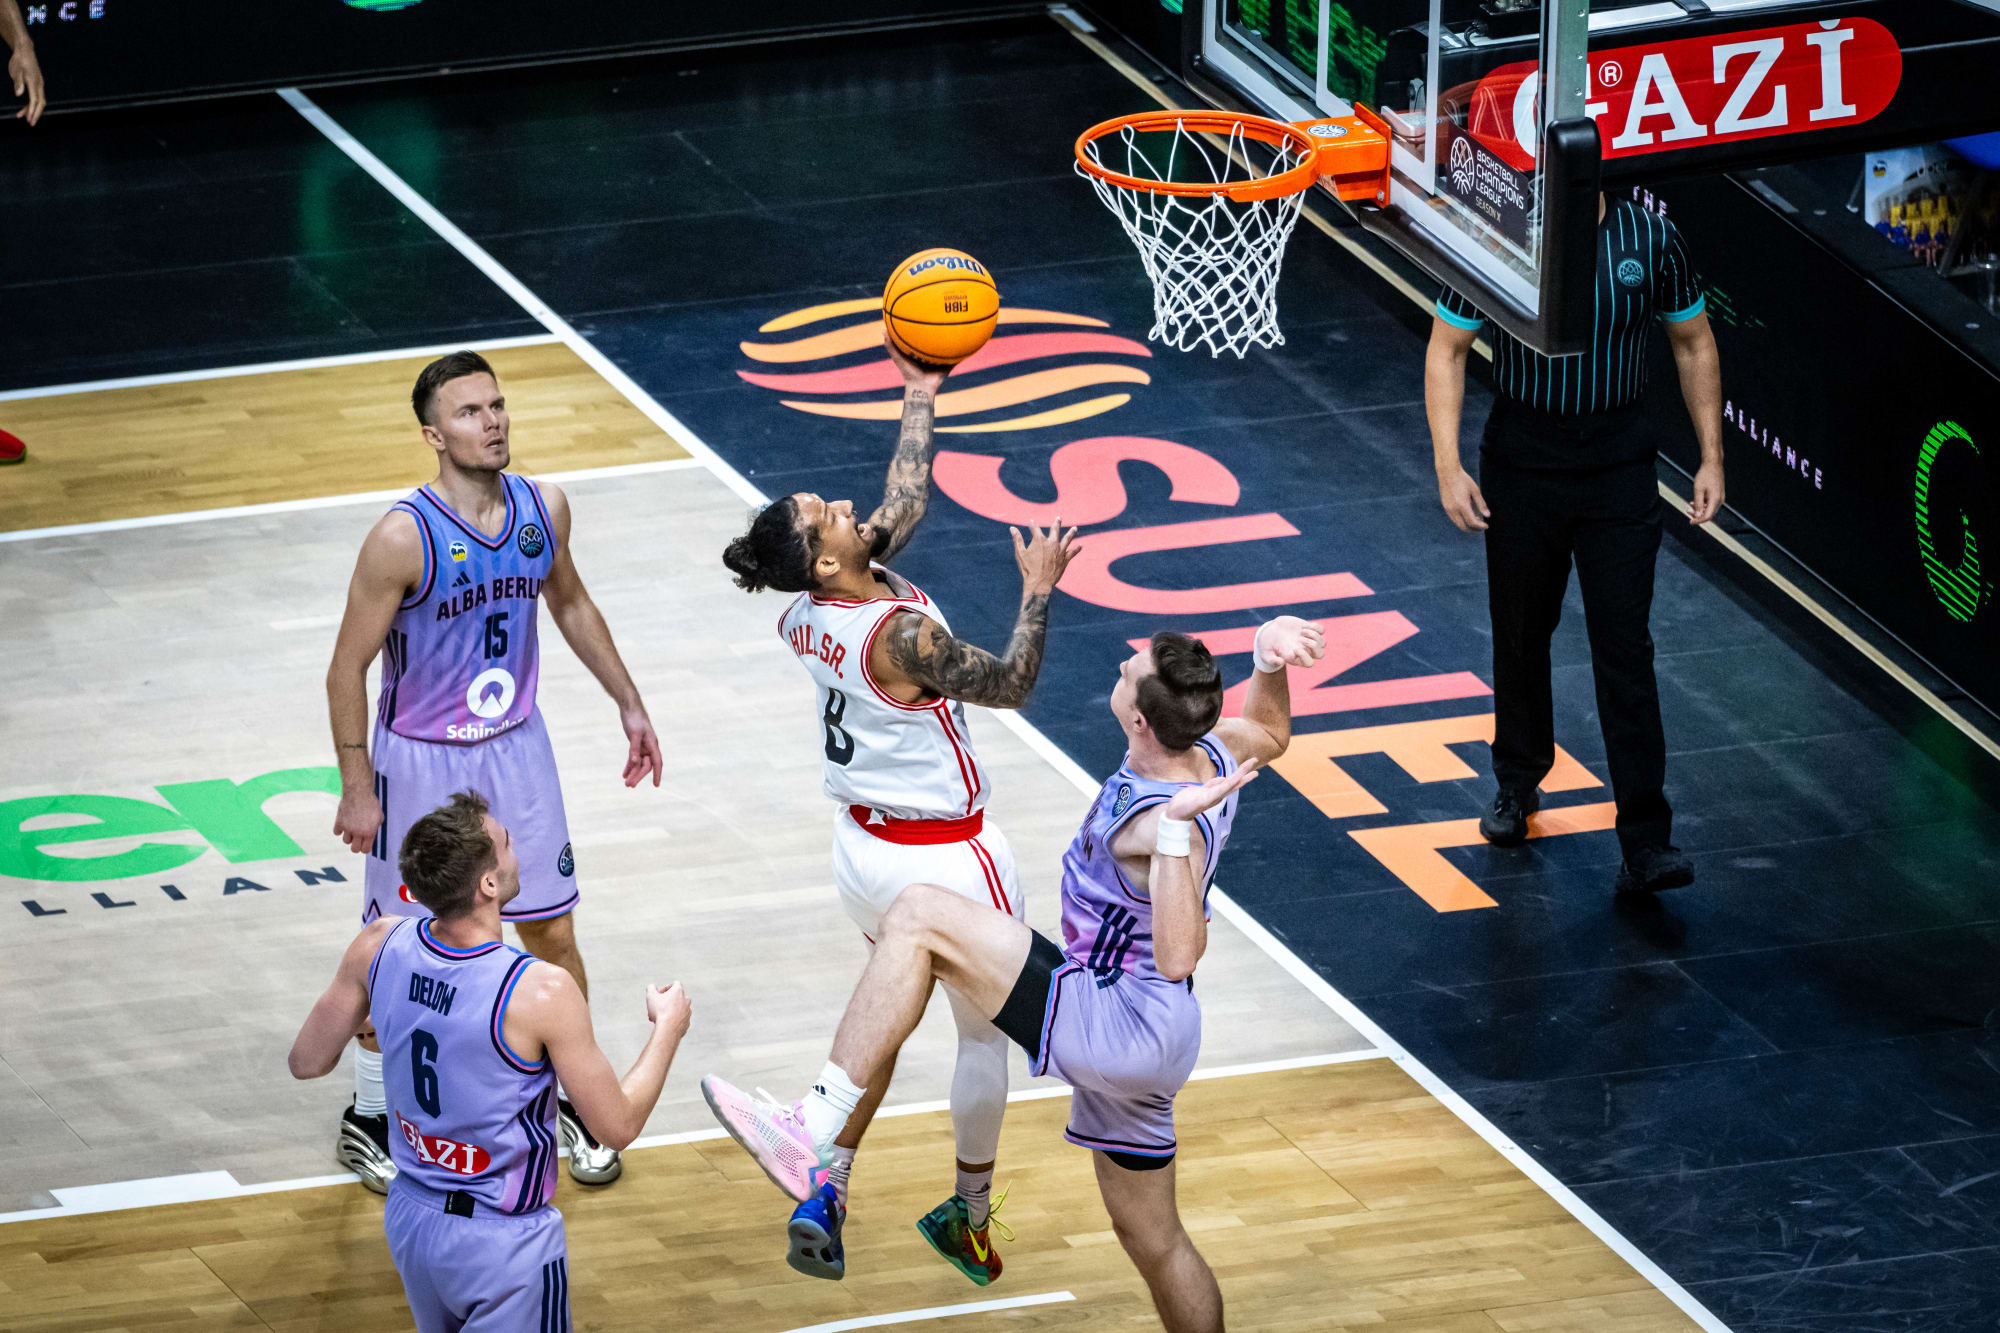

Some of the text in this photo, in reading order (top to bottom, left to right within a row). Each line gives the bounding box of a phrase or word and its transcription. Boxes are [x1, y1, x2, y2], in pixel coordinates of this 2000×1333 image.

[27, 0, 105, 25] NCE
[1476, 163, 1524, 210] CHAMPIONS
[1477, 150, 1519, 191] BASKETBALL
[1475, 178, 1502, 207] LEAGUE
[1475, 195, 1497, 219] SEASON
[909, 256, 985, 277] Wilson
[944, 301, 969, 313] FIBA
[1723, 400, 1823, 490] ALLIANCE
[436, 583, 488, 622] ALBA
[484, 611, 509, 660] 15
[819, 632, 847, 680] SR.
[932, 435, 1617, 913] SUNEL
[446, 716, 525, 740] Schindl
[20, 866, 348, 918] LLIAN
[408, 972, 457, 1017] DELOW
[410, 1028, 442, 1119] 6
